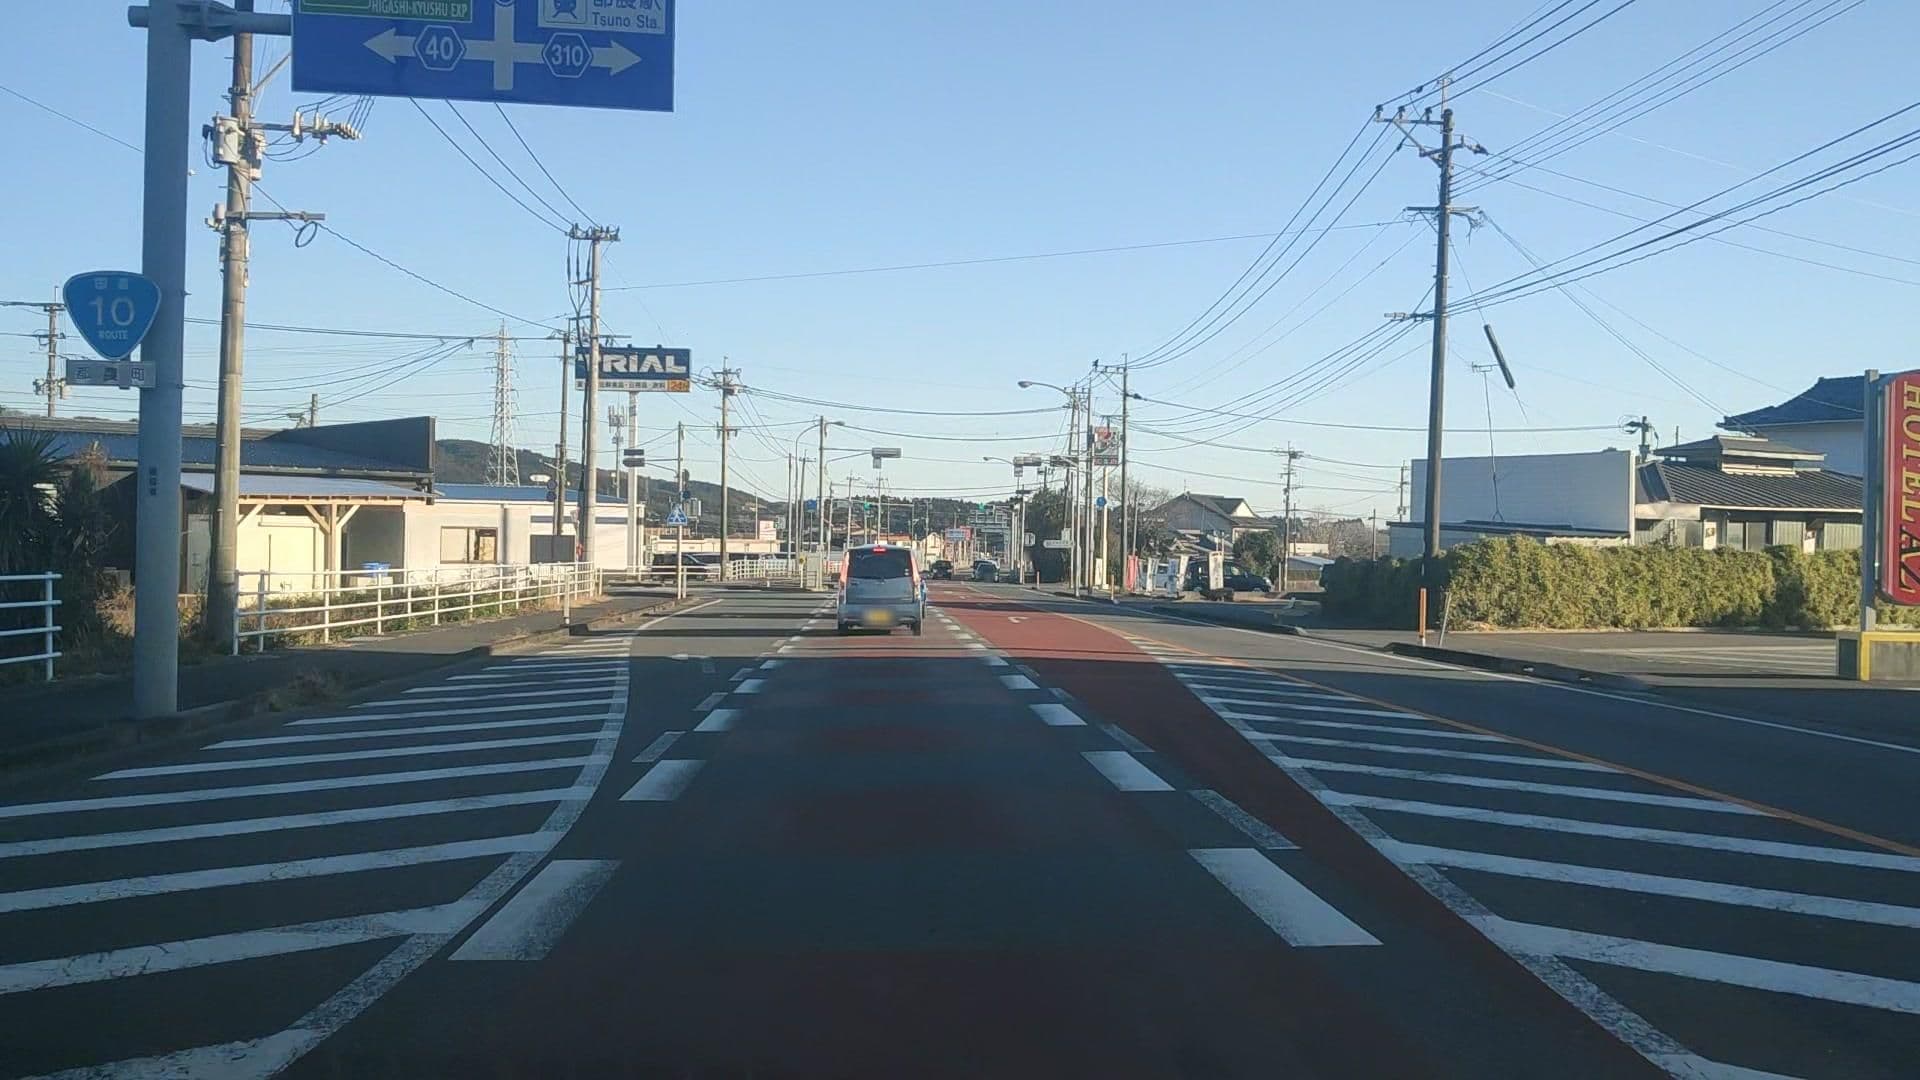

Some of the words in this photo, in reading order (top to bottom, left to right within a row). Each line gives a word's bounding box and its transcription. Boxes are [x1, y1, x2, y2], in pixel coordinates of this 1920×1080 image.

[450, 3, 468, 17] EXP
[592, 12, 631, 27] Tsuno
[425, 36, 454, 61] 40
[551, 45, 583, 67] 310
[91, 296, 134, 325] 10
[98, 330, 128, 340] ROUTE
